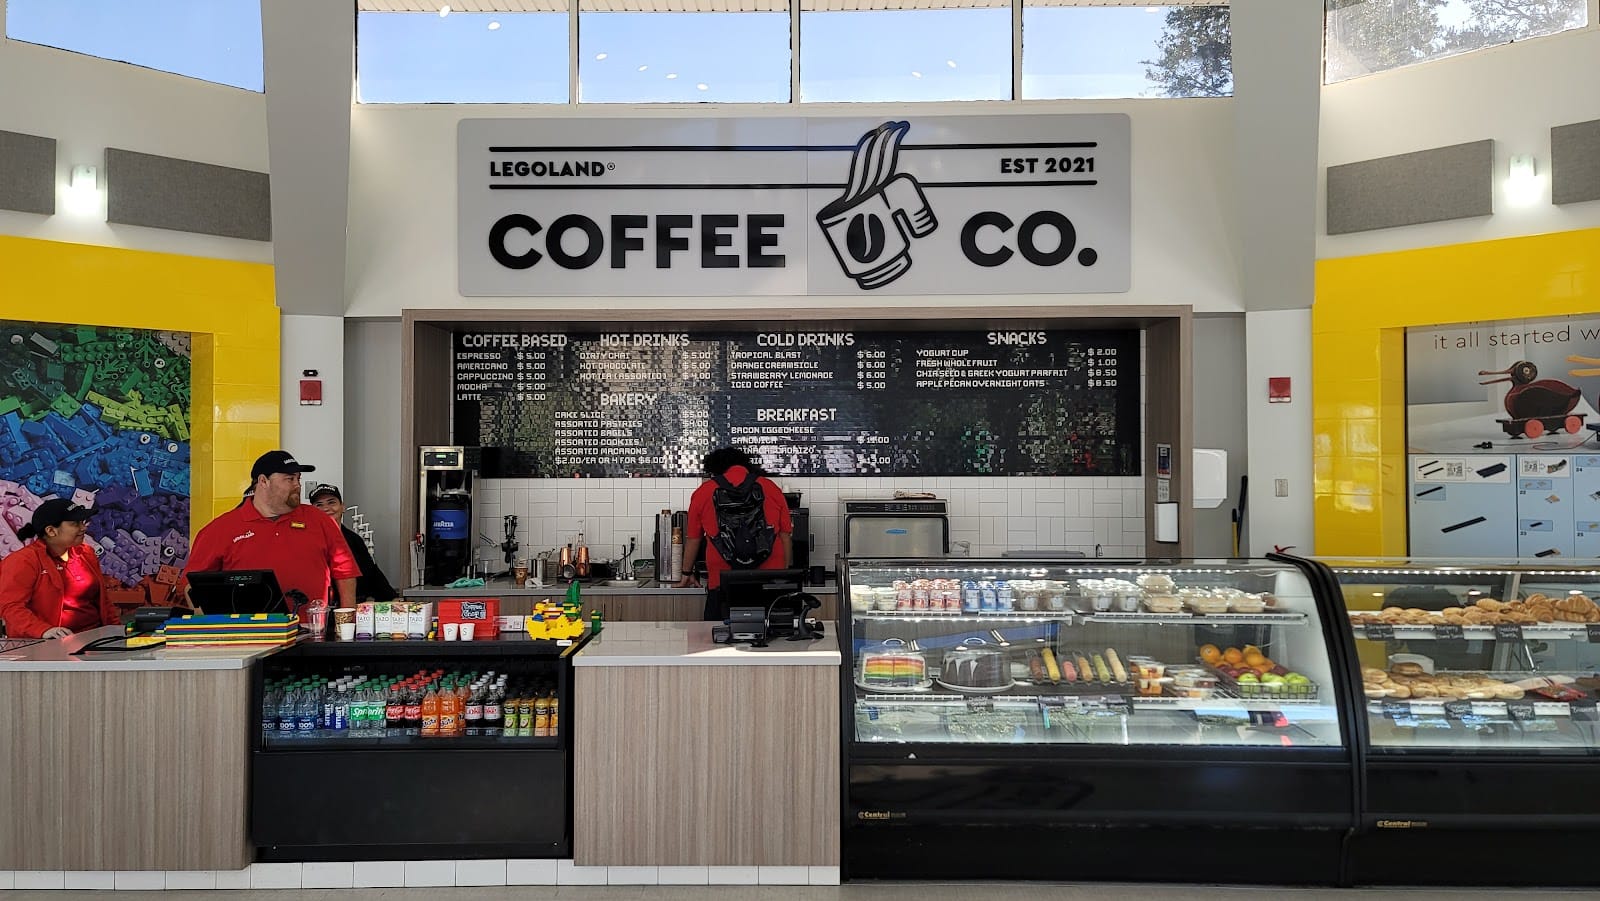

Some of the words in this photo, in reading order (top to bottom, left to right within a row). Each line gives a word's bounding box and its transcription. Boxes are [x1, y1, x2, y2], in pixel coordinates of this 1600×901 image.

[1000, 158, 1038, 173] EST
[1045, 157, 1095, 173] 2021
[488, 213, 785, 270] COFFEE
[959, 210, 1098, 268] CO.
[463, 334, 518, 347] COFFEE
[522, 334, 567, 347] BASED
[600, 334, 630, 347] HOT
[634, 334, 690, 347] DRINKS
[757, 333, 794, 347] COLD
[798, 333, 855, 347] DRINKS
[987, 332, 1047, 345] SNACKS
[1434, 334, 1448, 350] it
[1456, 331, 1479, 349] all
[1489, 325, 1570, 347] started
[580, 352, 607, 360] DIRTY
[609, 352, 630, 360] CHAI
[731, 351, 773, 359] TROPICAL
[775, 351, 801, 359] BLAST
[580, 362, 595, 370] HOT
[457, 383, 488, 391] MOCHA
[731, 381, 751, 389] ICED
[754, 381, 784, 389] COFFEE
[600, 393, 658, 406] BAKERY
[554, 411, 578, 419] CAKE
[579, 411, 606, 419] SLICE
[757, 408, 837, 422] BREAKFAST
[554, 420, 599, 428] ASSORTED
[600, 420, 643, 428] PASTRIES
[554, 429, 599, 437] ASSORTED
[600, 429, 633, 437] BAGELS
[554, 438, 599, 446] ASSORTED
[600, 438, 640, 446] COOKIES
[554, 447, 599, 455] ASSORTED
[600, 447, 648, 455] MACARONS
[554, 456, 597, 465] $2.00/EA
[638, 456, 665, 465] $6.00
